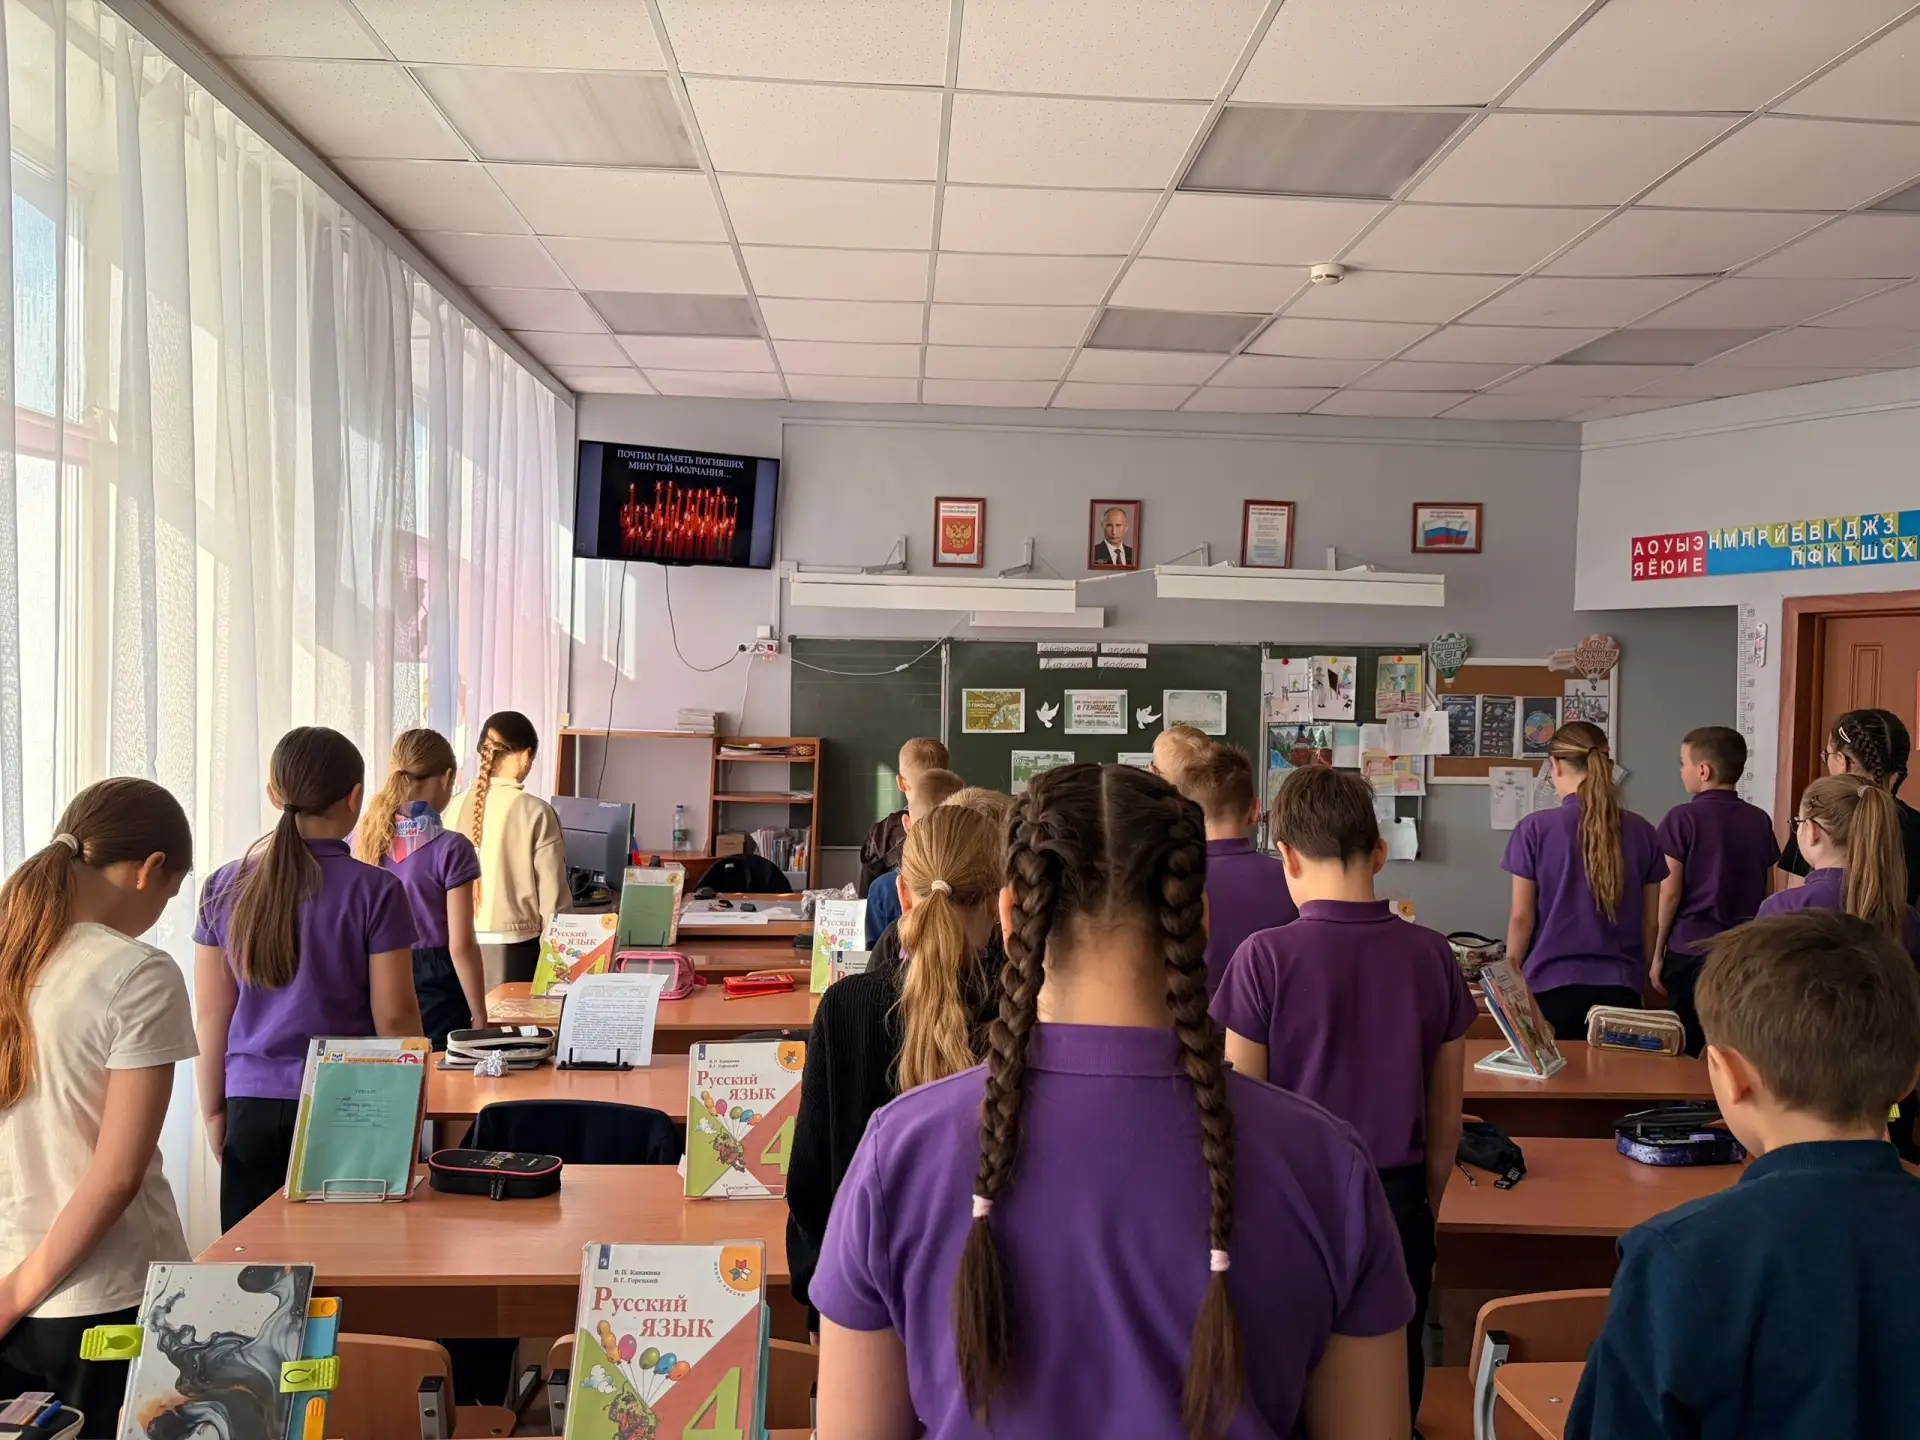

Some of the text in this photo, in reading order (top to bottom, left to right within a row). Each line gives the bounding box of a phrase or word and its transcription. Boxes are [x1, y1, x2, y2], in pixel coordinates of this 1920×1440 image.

[617, 449, 744, 468] ПОЧТИМ ПАМЯТЬ ПОГИБШИХ
[628, 461, 732, 478] МИНУТОЙ МОЛЧАНИЯ...
[1566, 698, 1579, 709] 20
[1566, 709, 1580, 720] 26
[820, 915, 856, 927] Русский
[549, 927, 588, 938] Русский
[696, 1070, 758, 1088] Русский
[761, 1115, 795, 1175] 4
[592, 1286, 688, 1316] Русский
[682, 1367, 743, 1440] 4
